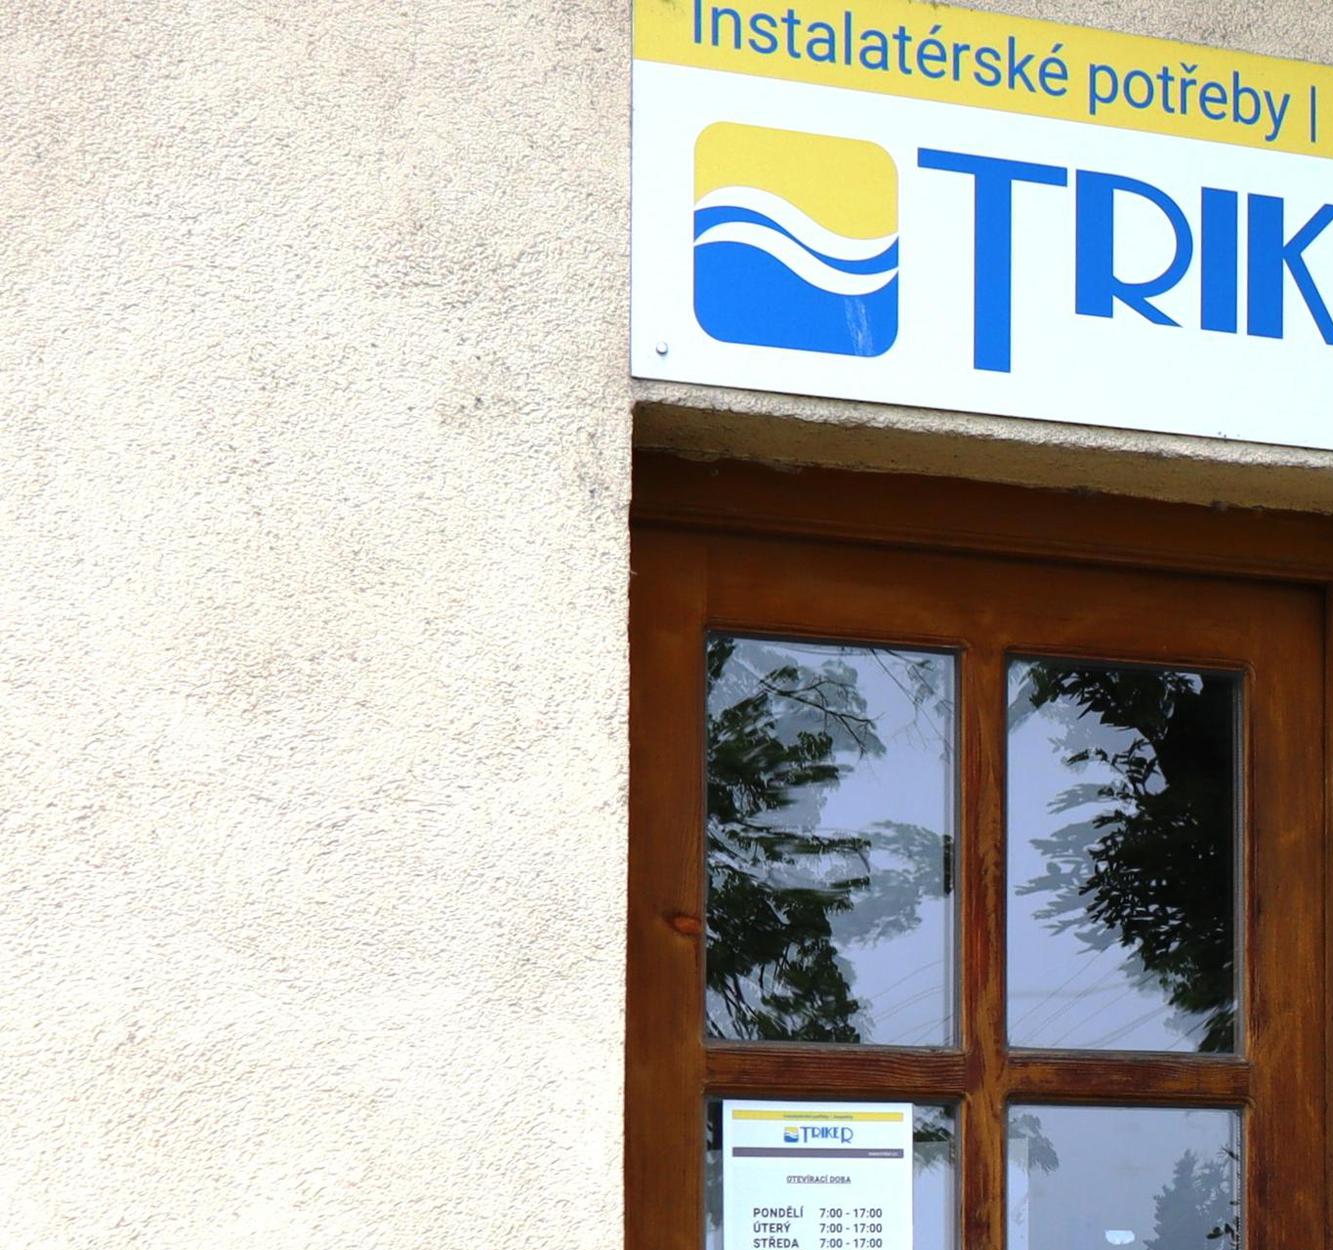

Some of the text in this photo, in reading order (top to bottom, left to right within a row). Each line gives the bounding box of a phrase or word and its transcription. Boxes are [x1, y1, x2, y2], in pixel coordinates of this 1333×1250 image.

[693, 0, 1069, 96] Instalatérské
[1088, 62, 1291, 142] potřeby
[800, 1127, 853, 1143] TRIKER
[754, 1206, 803, 1218] PONDĚLÍ
[820, 1208, 843, 1218] 7:00
[854, 1208, 883, 1218] 17:00
[754, 1221, 791, 1233] ÚTERÝ
[820, 1223, 843, 1233] 7:00
[854, 1223, 883, 1233] 17:00
[754, 1236, 799, 1249] STŘEDA
[820, 1238, 843, 1248] 7:00
[854, 1238, 883, 1248] 17:00
